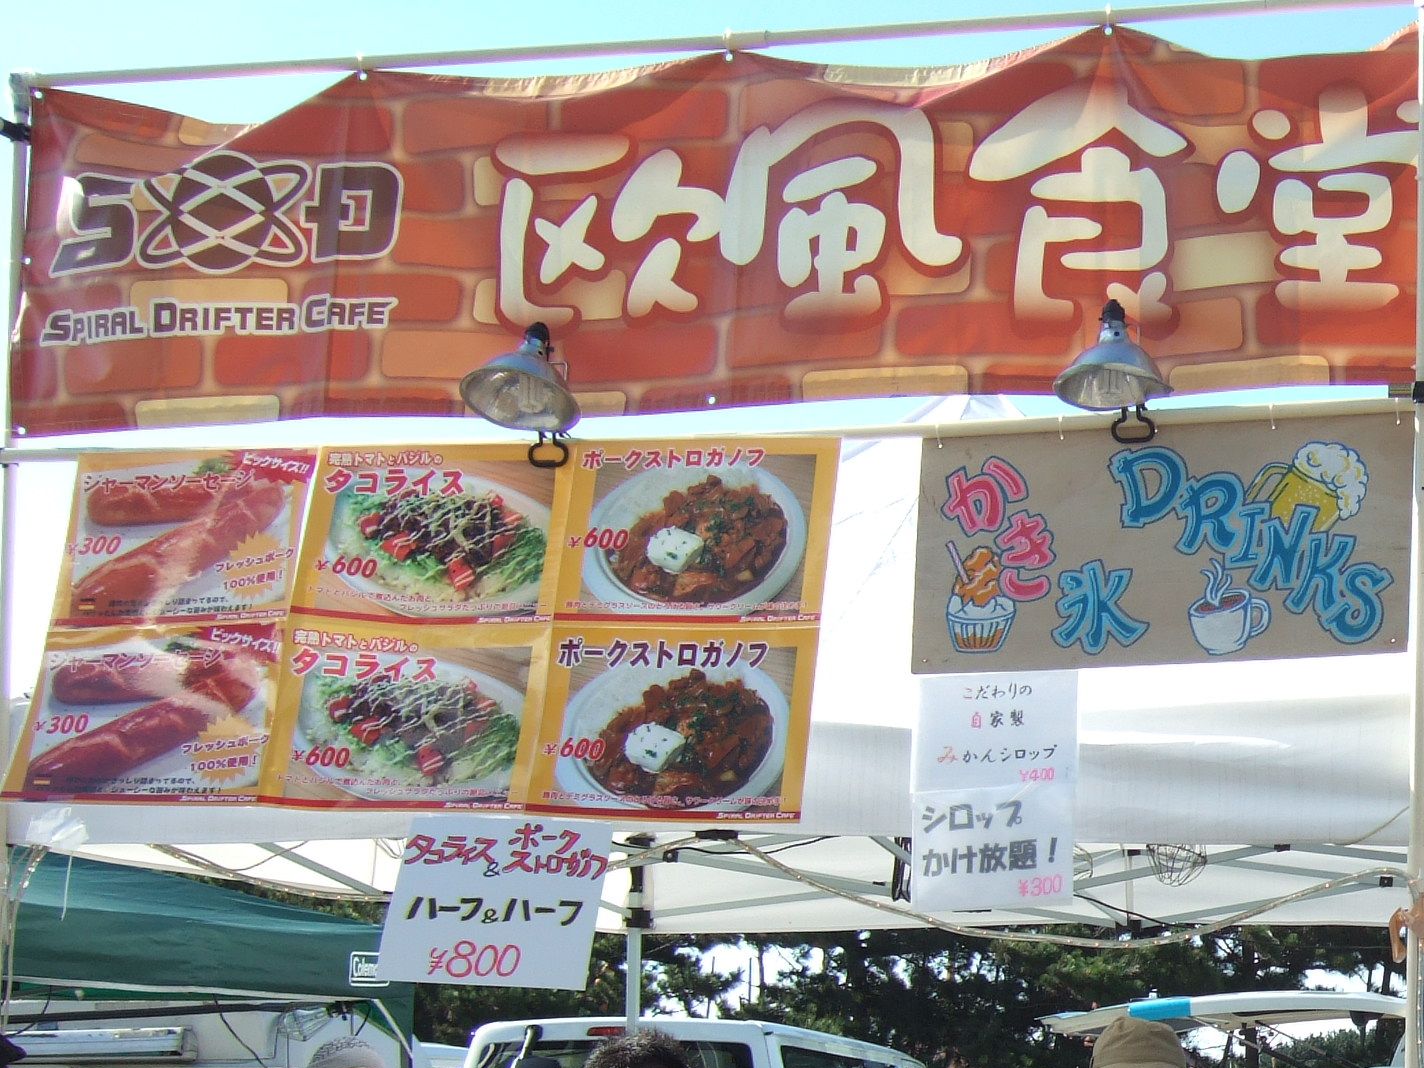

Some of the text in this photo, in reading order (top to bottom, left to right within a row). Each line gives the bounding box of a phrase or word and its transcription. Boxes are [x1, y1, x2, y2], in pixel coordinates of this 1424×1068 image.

[40, 295, 398, 347] SPIRAL DRIFTER CAFE
[582, 446, 767, 470] ポークストロガノフ
[84, 468, 255, 494] ジャーマンソーセージ
[324, 467, 466, 498] タコライス
[67, 535, 122, 556] ¥300
[568, 527, 630, 551] ¥600
[1108, 445, 1394, 645] DRINKS
[215, 549, 294, 573] フレッシュポーク
[316, 554, 378, 580] ¥600
[291, 647, 438, 682] タコライス
[558, 637, 770, 670] ポークストロガノフ
[962, 681, 1033, 700] こだわりの
[34, 713, 89, 735] ¥300
[970, 708, 1025, 730] 自家製
[181, 733, 270, 755] フレッシュポーク
[291, 745, 350, 768] ¥600
[543, 736, 606, 761] ¥600
[937, 744, 1057, 764] みかんシロップ
[921, 799, 1023, 834] シロップ
[508, 822, 581, 855] ポーク
[404, 834, 500, 878] タコライス &
[502, 848, 609, 880] ストロガノフ
[1018, 874, 1064, 898] ¥300
[427, 940, 522, 979] ¥800
